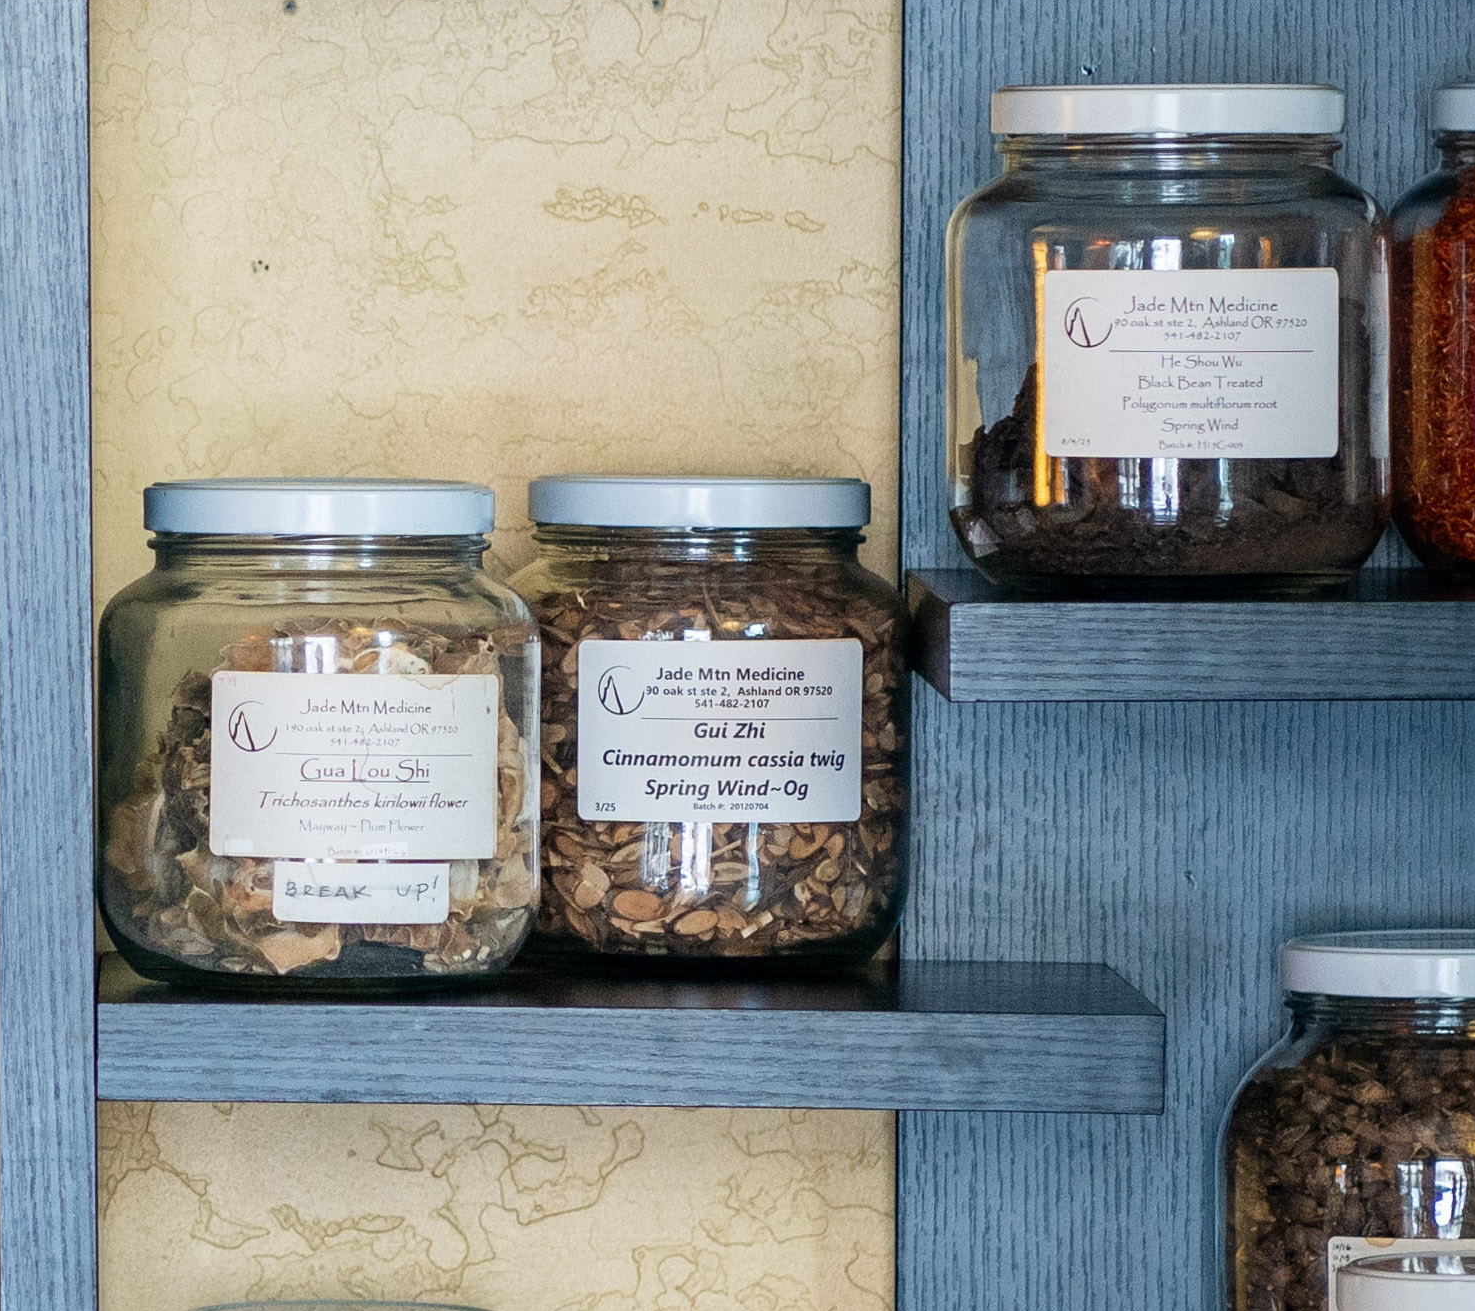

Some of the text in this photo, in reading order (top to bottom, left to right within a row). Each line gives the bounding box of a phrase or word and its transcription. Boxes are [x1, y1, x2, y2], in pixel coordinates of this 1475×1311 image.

[1161, 355, 1242, 369] He Shou Wu
[694, 722, 765, 738] Gui Zhi
[300, 760, 430, 780] Gua Lou Shi
[603, 749, 845, 771] Cinnamomum cassia twig
[285, 876, 438, 902] BREAK UP!
